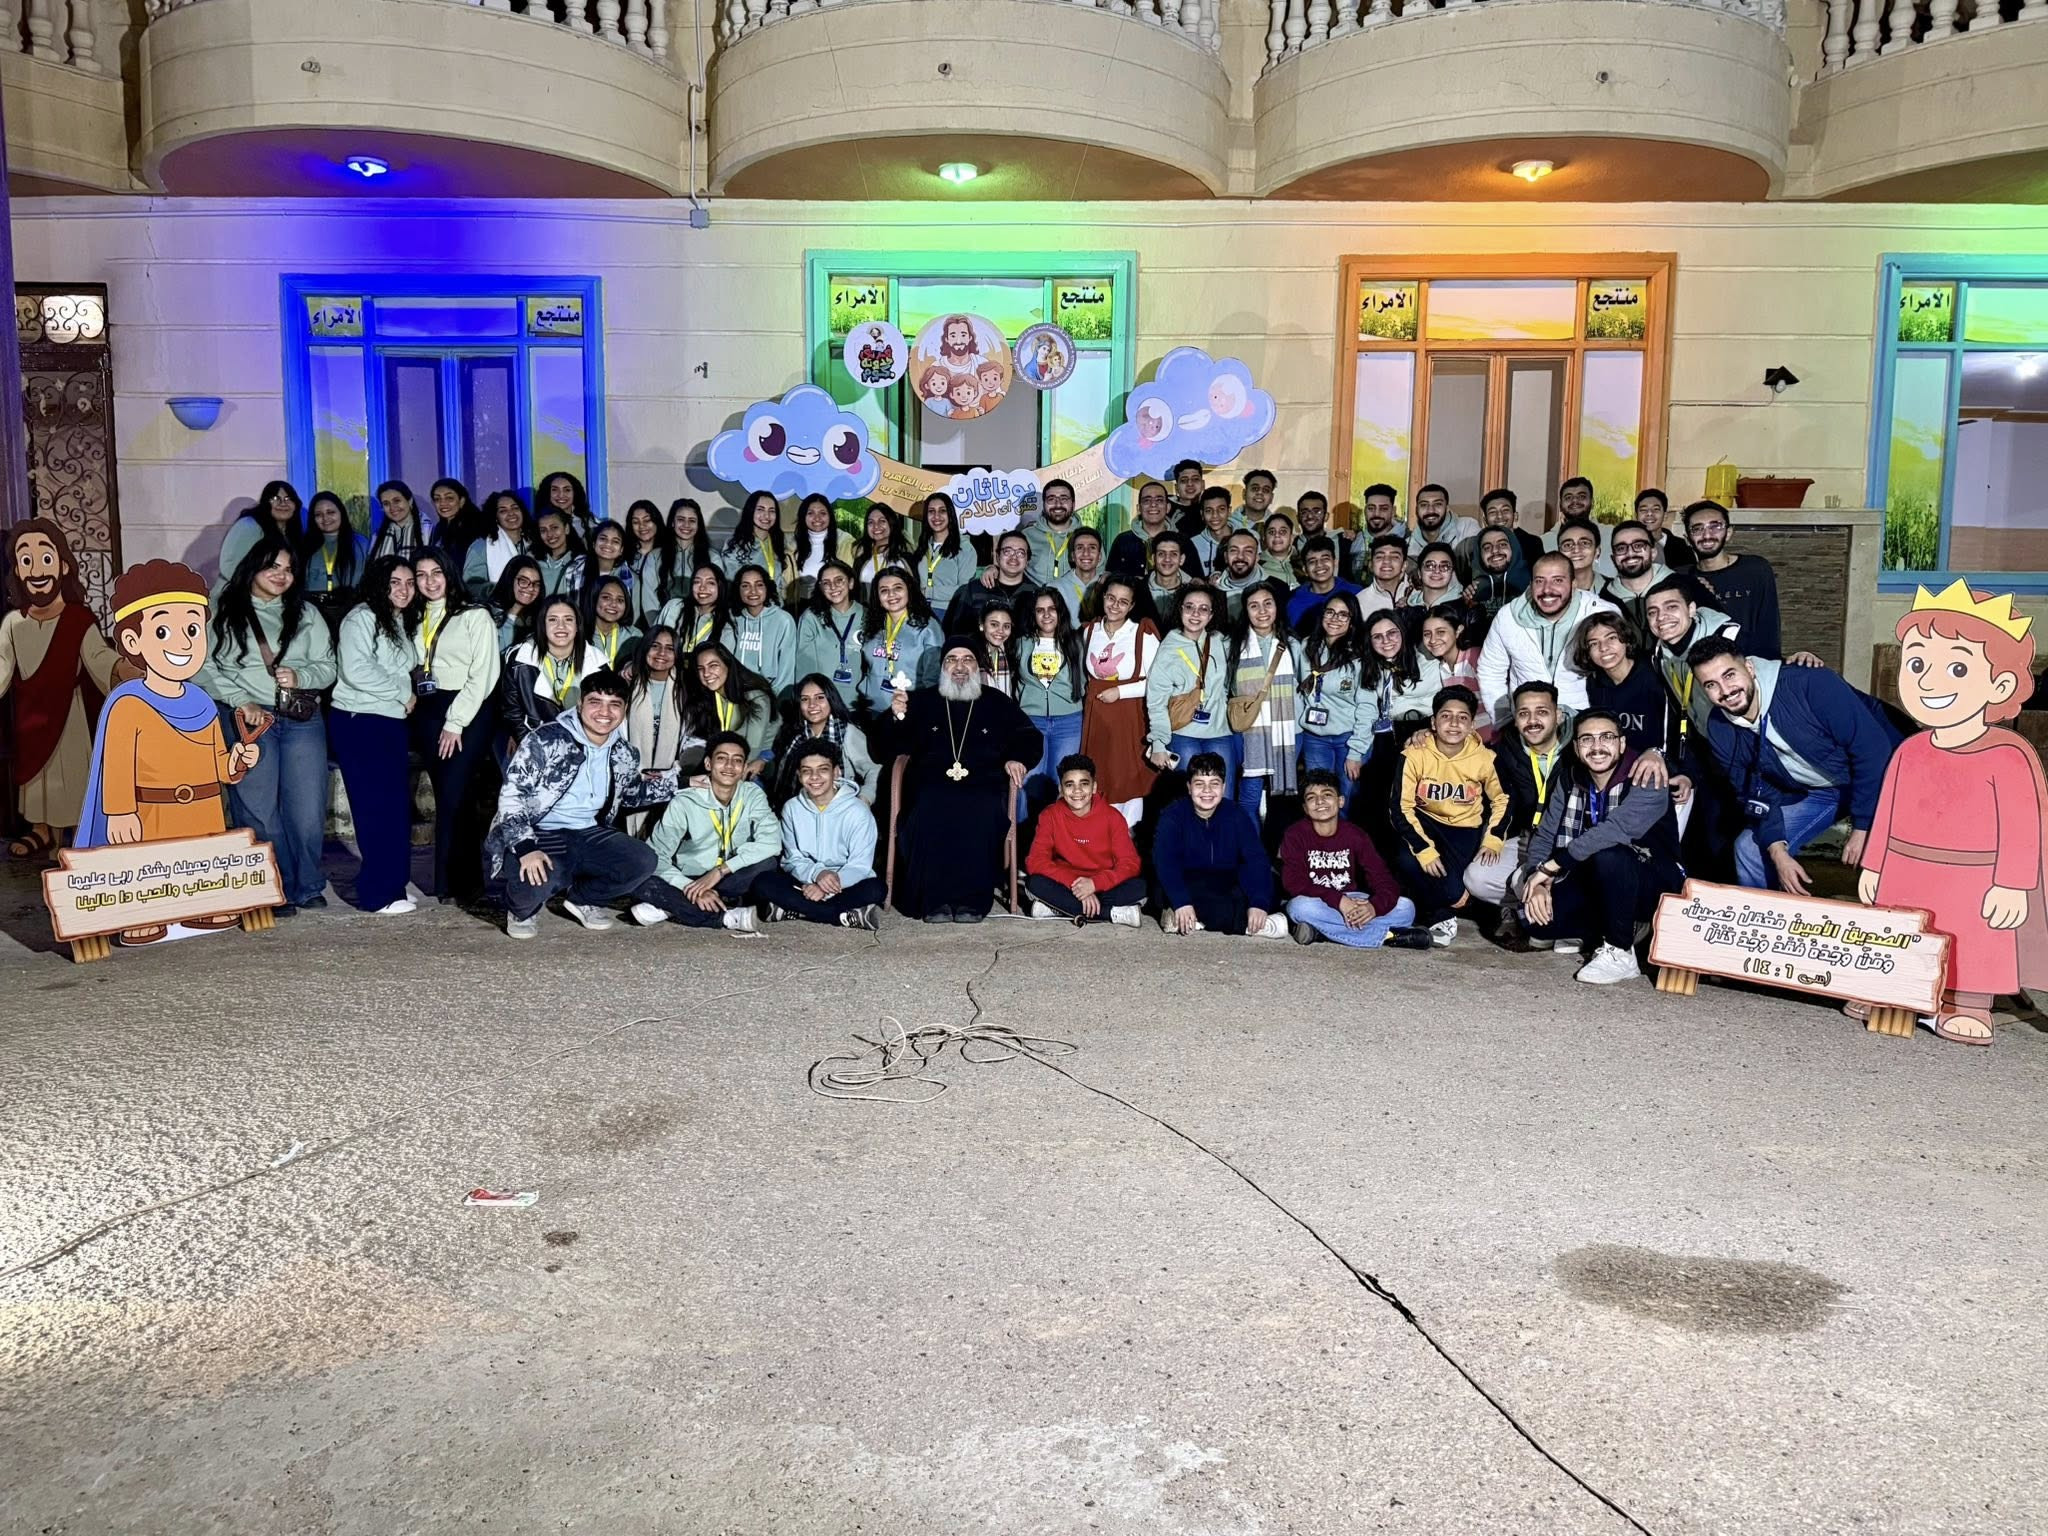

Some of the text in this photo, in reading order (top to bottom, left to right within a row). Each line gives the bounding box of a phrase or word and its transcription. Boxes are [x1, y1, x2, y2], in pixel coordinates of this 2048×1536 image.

[1060, 286, 1105, 310] منتجع
[1592, 288, 1638, 311] منتجع
[536, 305, 580, 327] منتجع
[952, 477, 1037, 508] يوناثان
[959, 498, 1001, 529] كلام
[137, 861, 171, 881] بشكر
[173, 860, 210, 875] جميلة
[68, 872, 106, 890] عليها
[183, 872, 229, 896] أصحاب
[119, 889, 134, 904] دا
[136, 883, 180, 904] والحب
